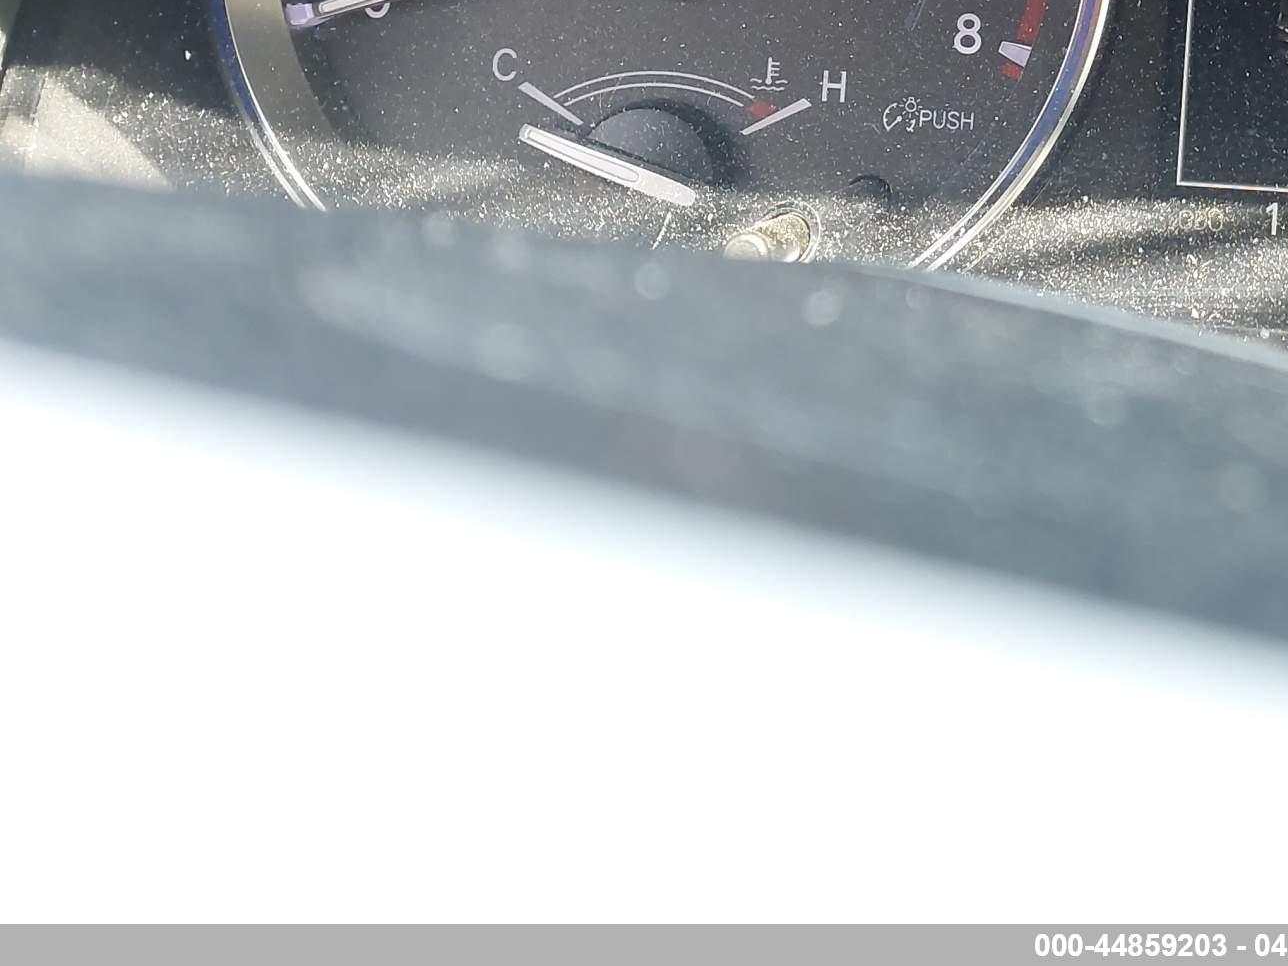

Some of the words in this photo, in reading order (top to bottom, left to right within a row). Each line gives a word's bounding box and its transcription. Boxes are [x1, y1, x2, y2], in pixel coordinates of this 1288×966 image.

[952, 13, 982, 55] 8
[492, 48, 518, 82] C
[821, 70, 847, 103] H
[919, 109, 975, 131] PUSH
